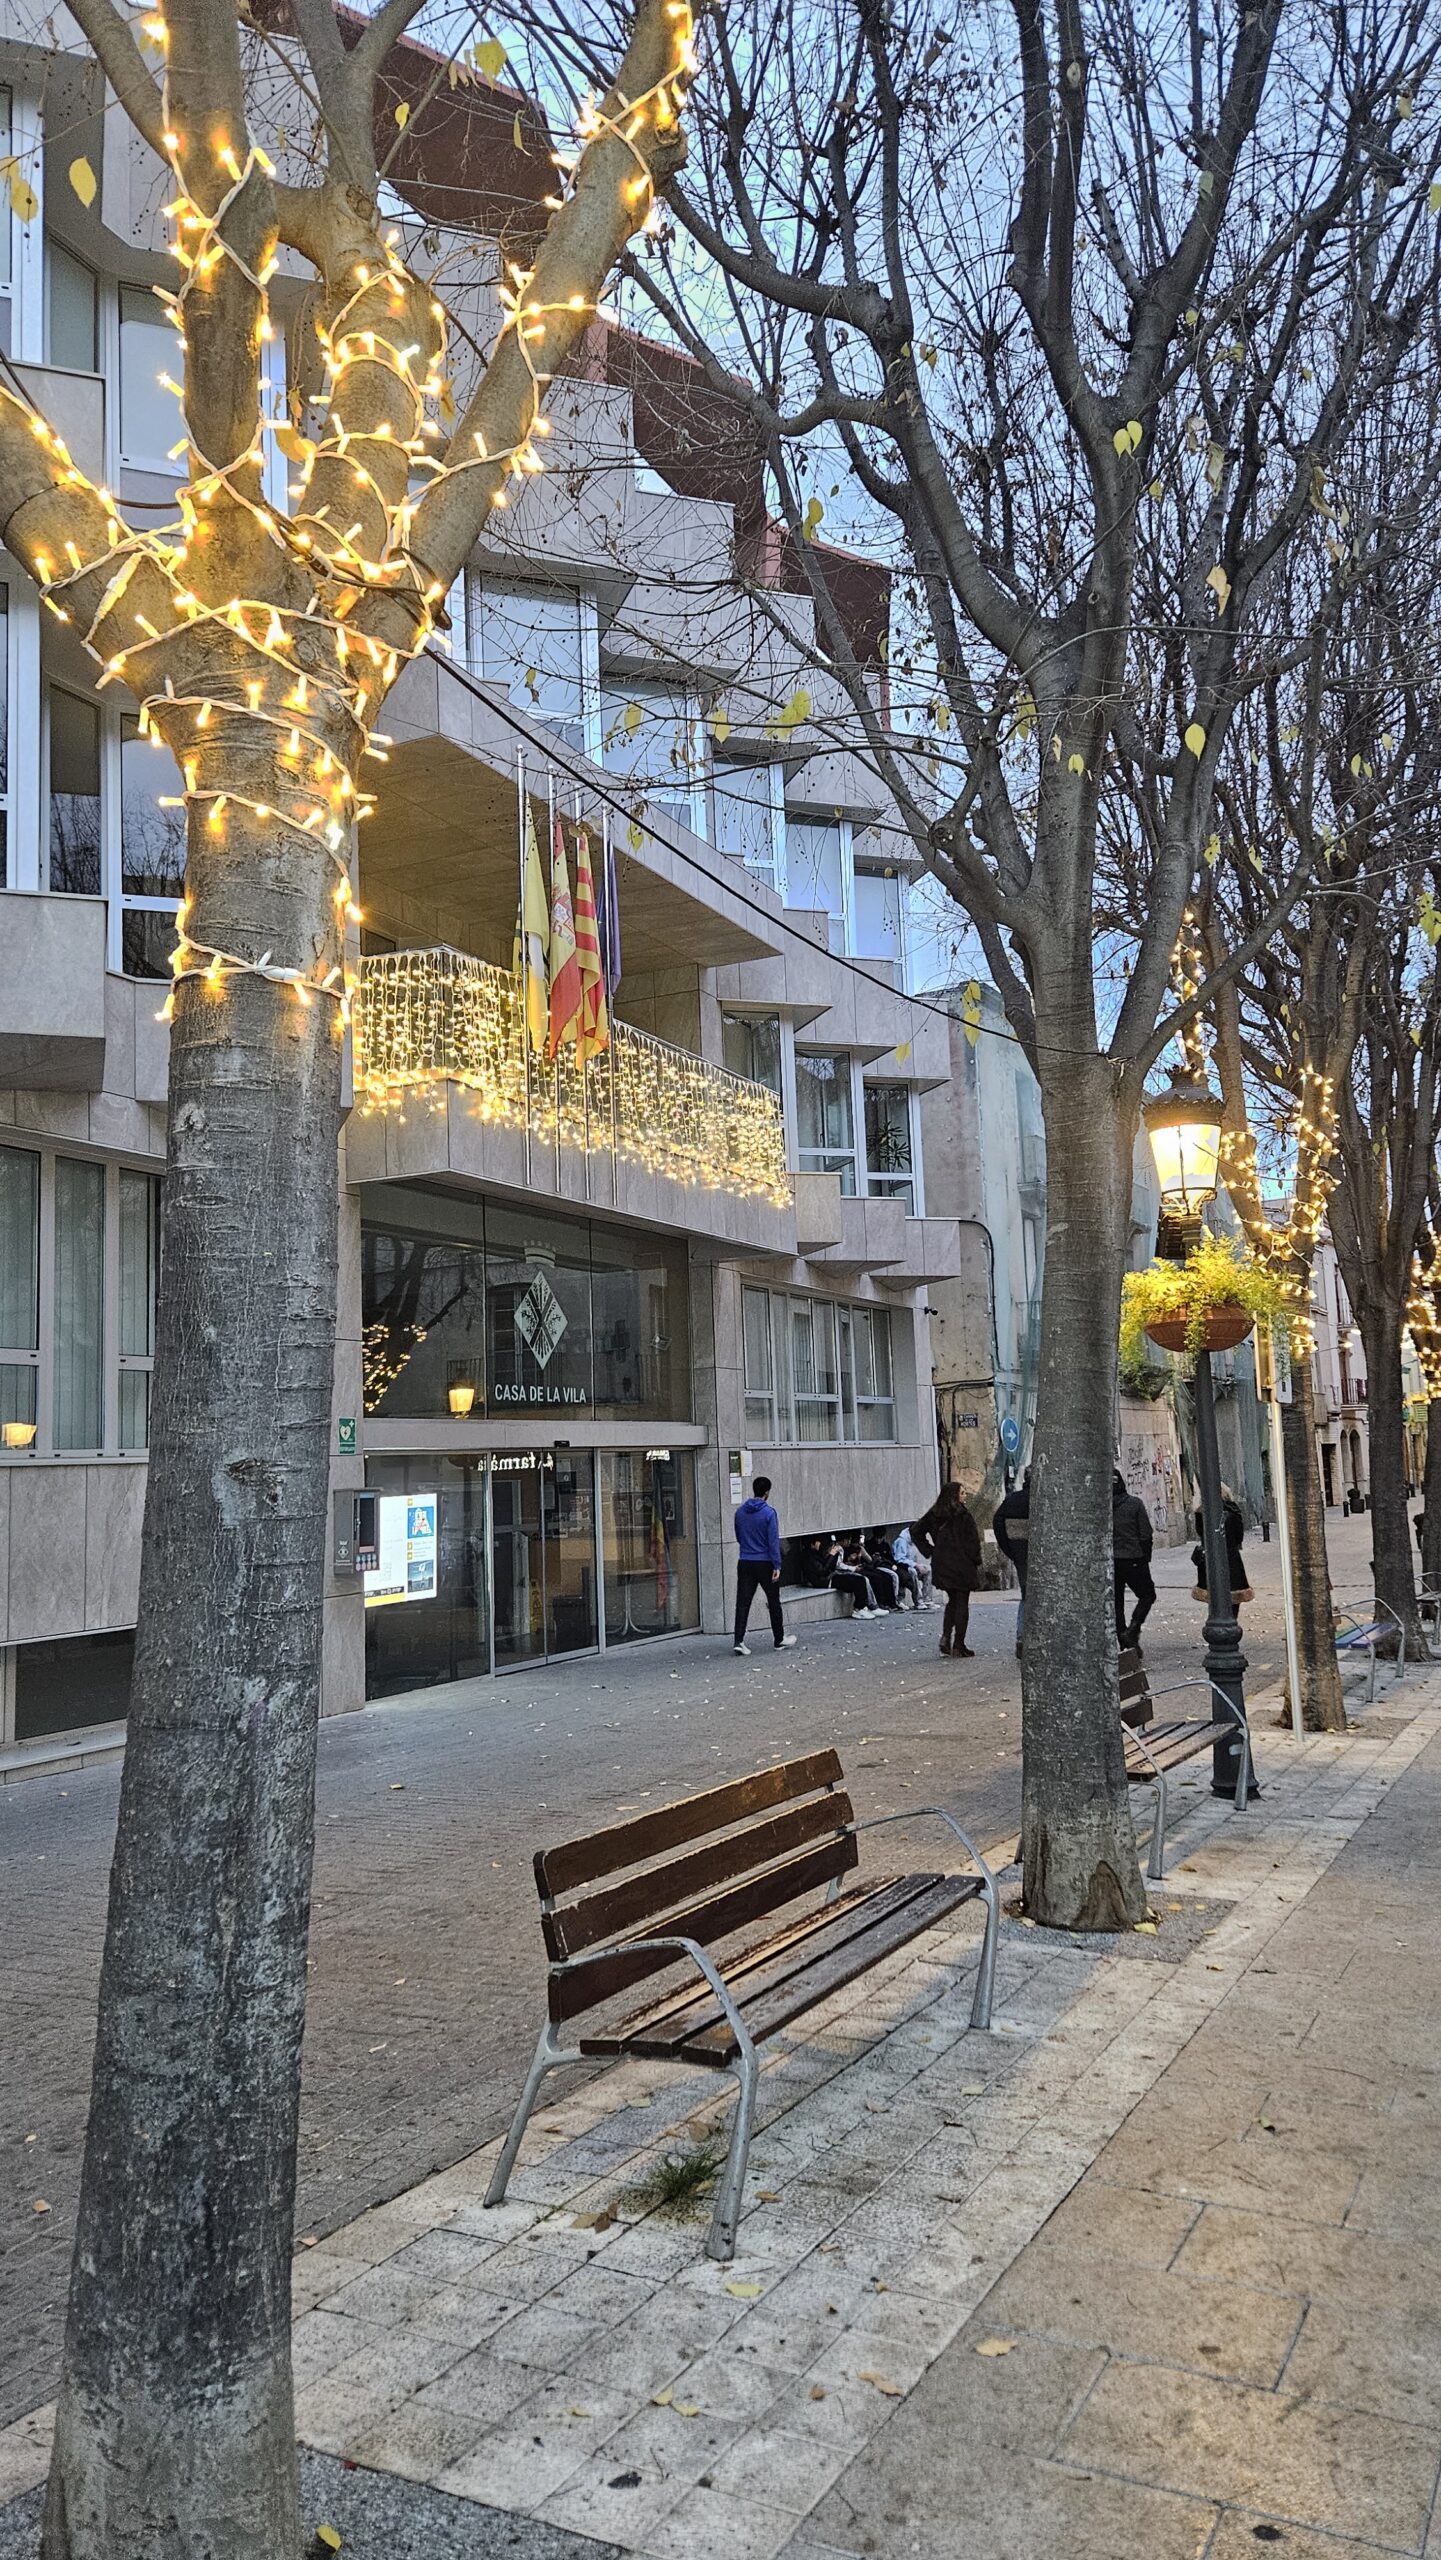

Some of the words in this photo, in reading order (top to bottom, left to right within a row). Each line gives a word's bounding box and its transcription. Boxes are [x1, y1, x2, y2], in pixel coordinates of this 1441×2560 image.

[495, 1384, 527, 1401] CASA
[529, 1385, 544, 1402] DE
[547, 1386, 561, 1402] LA
[563, 1386, 587, 1403] VILA
